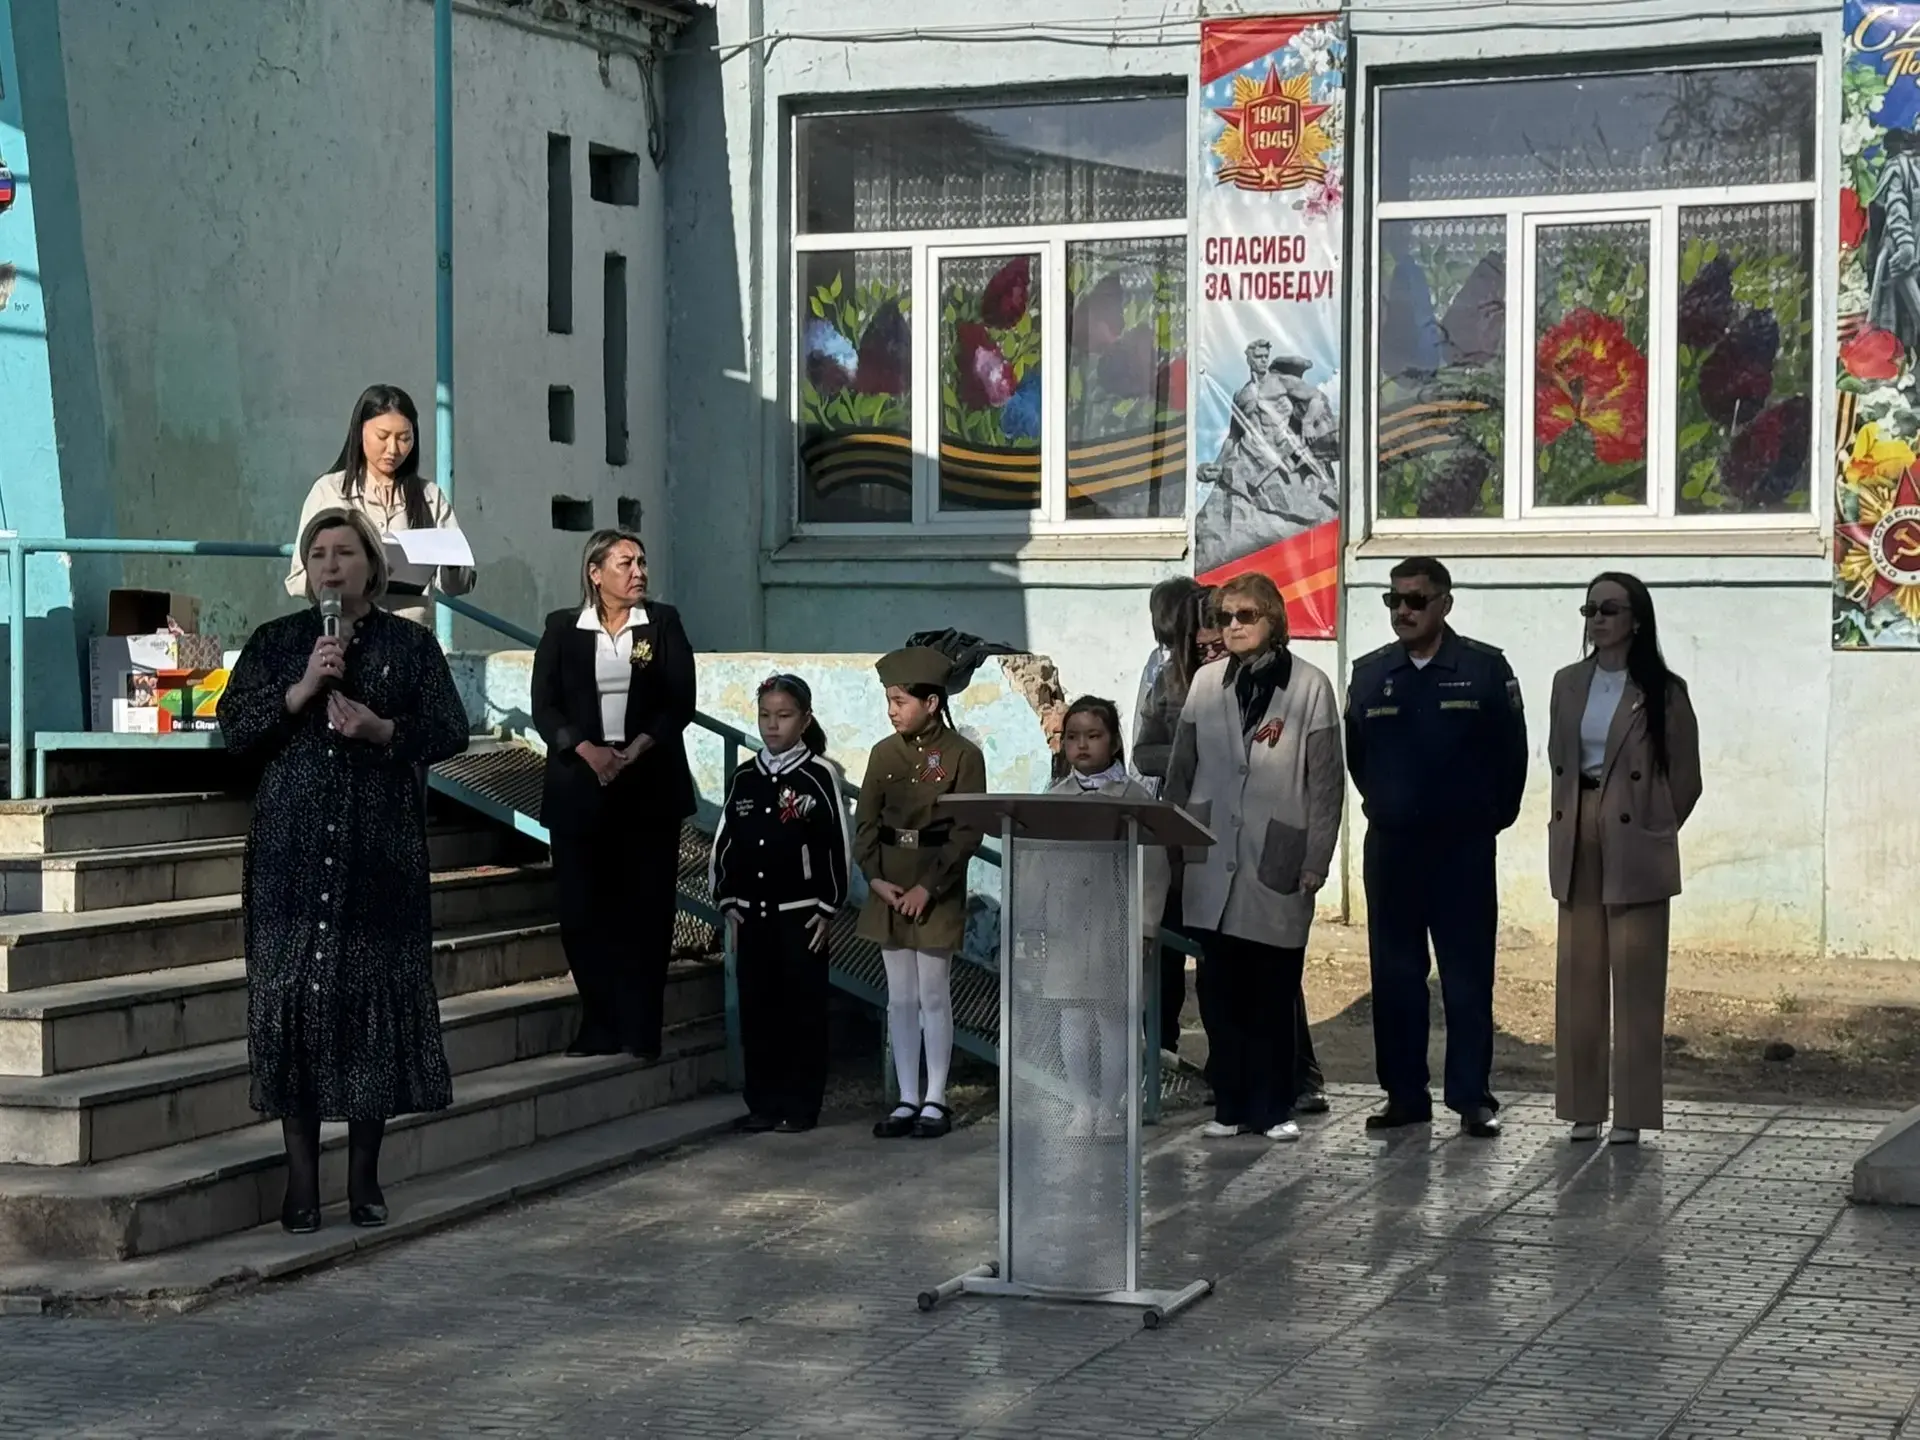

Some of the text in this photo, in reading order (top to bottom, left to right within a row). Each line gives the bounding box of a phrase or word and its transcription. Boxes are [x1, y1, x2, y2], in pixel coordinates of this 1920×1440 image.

[1251, 104, 1291, 125] 1941
[1250, 130, 1294, 150] 1945
[1205, 235, 1306, 266] СПАСИБО
[1205, 270, 1334, 302] ЗА ПОБЕДУ!
